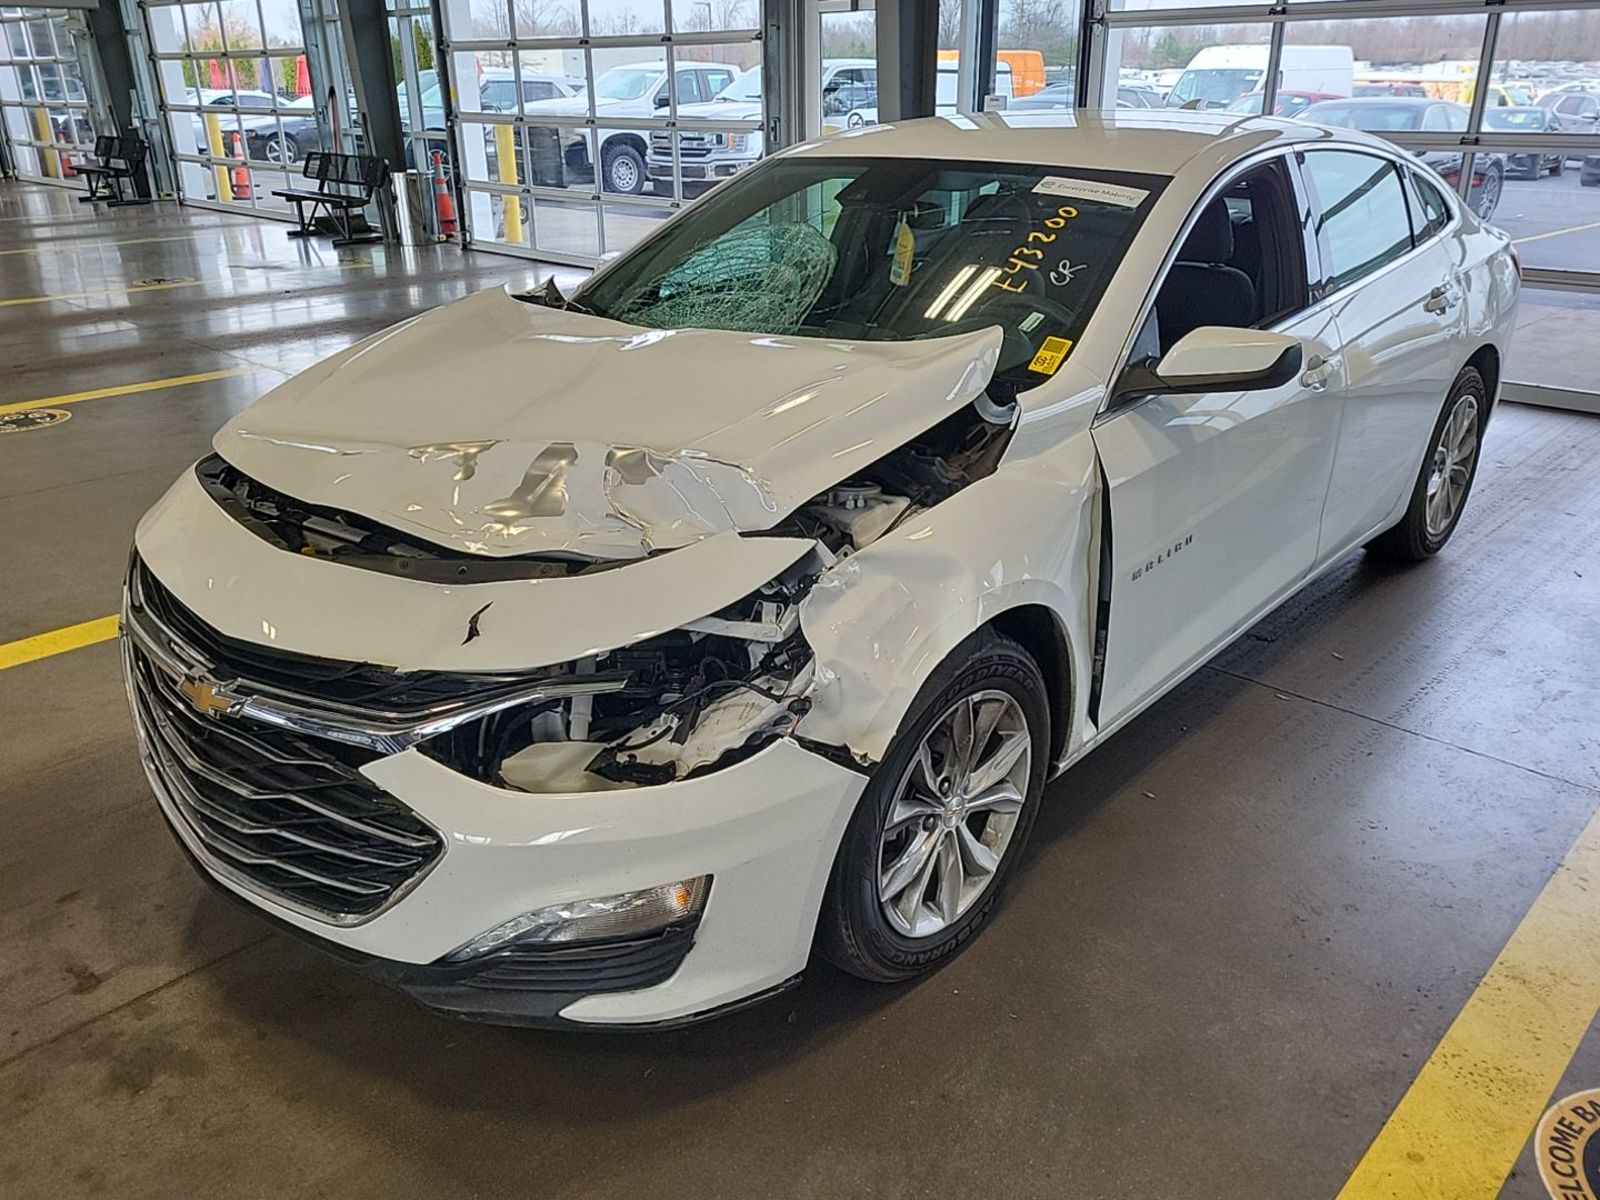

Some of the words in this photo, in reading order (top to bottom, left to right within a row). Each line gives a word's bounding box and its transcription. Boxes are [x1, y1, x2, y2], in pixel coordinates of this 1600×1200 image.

[1057, 183, 1099, 195] Enterprise
[1101, 190, 1136, 202] Mobility
[933, 664, 1035, 714] GOODYEAR
